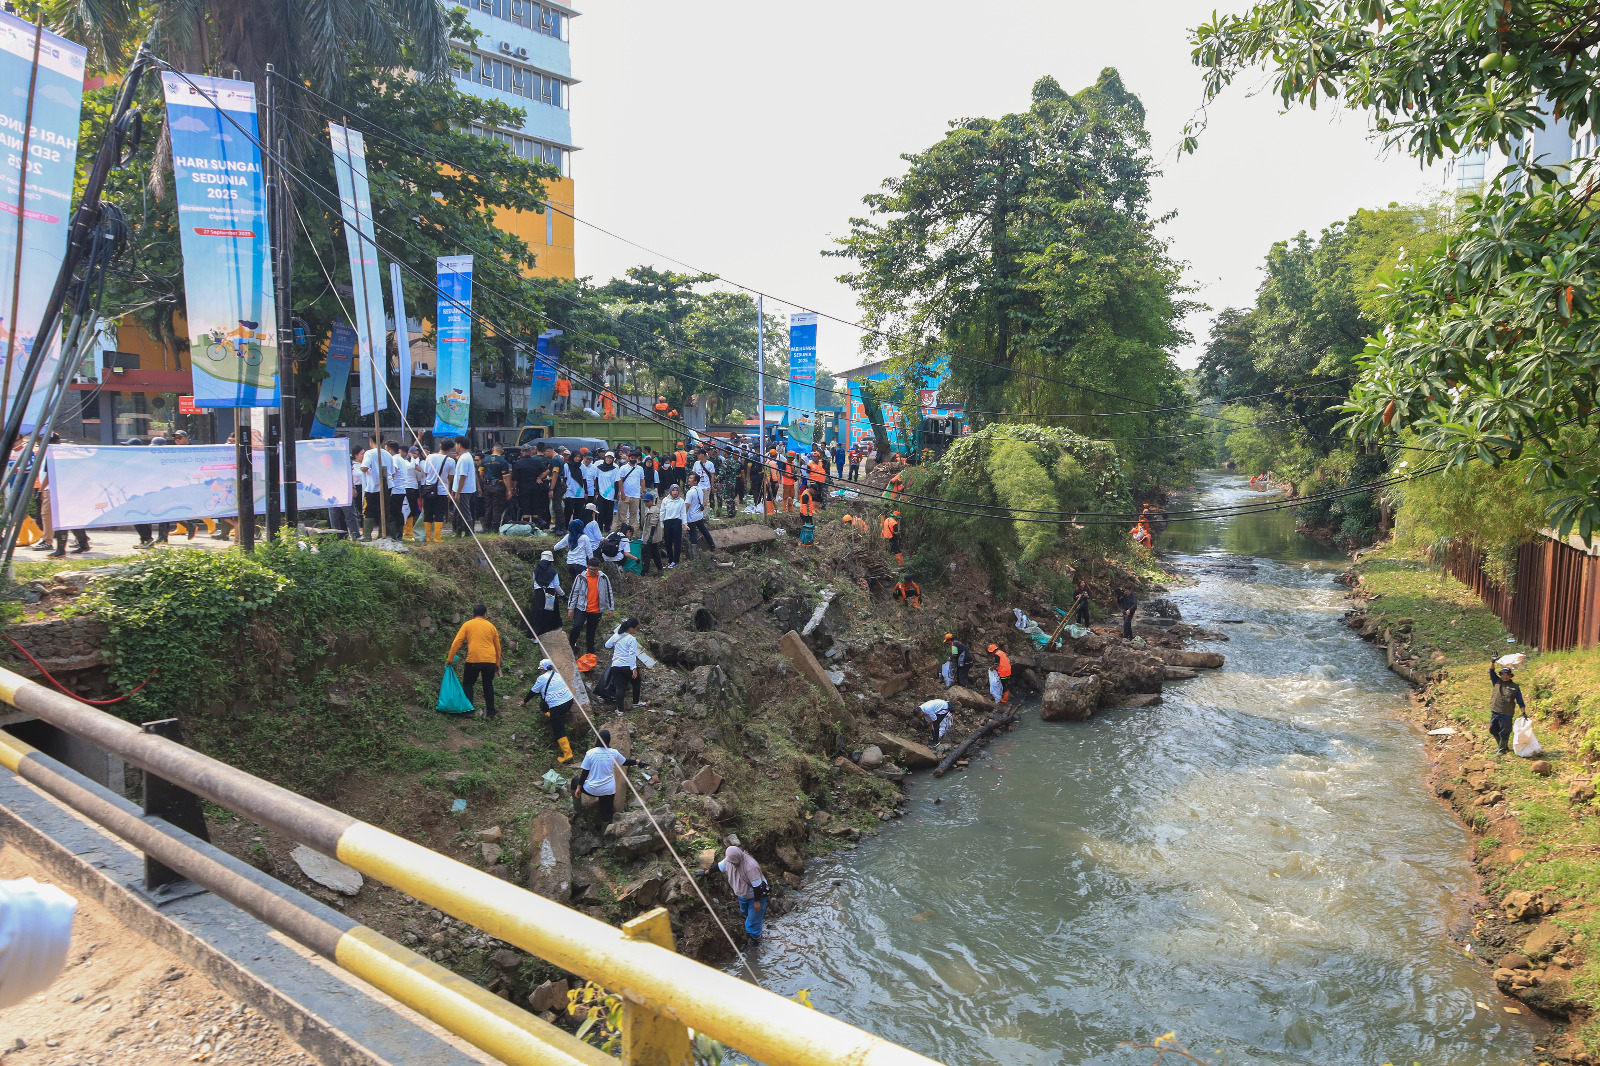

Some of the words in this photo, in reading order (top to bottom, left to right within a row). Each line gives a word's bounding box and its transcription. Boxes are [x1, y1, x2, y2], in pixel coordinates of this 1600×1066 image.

[176, 156, 208, 169] HARI
[211, 160, 260, 173] SUNGAI
[192, 172, 248, 186] SEDUNIA
[207, 188, 238, 199] 2025
[180, 204, 211, 212] Bersama
